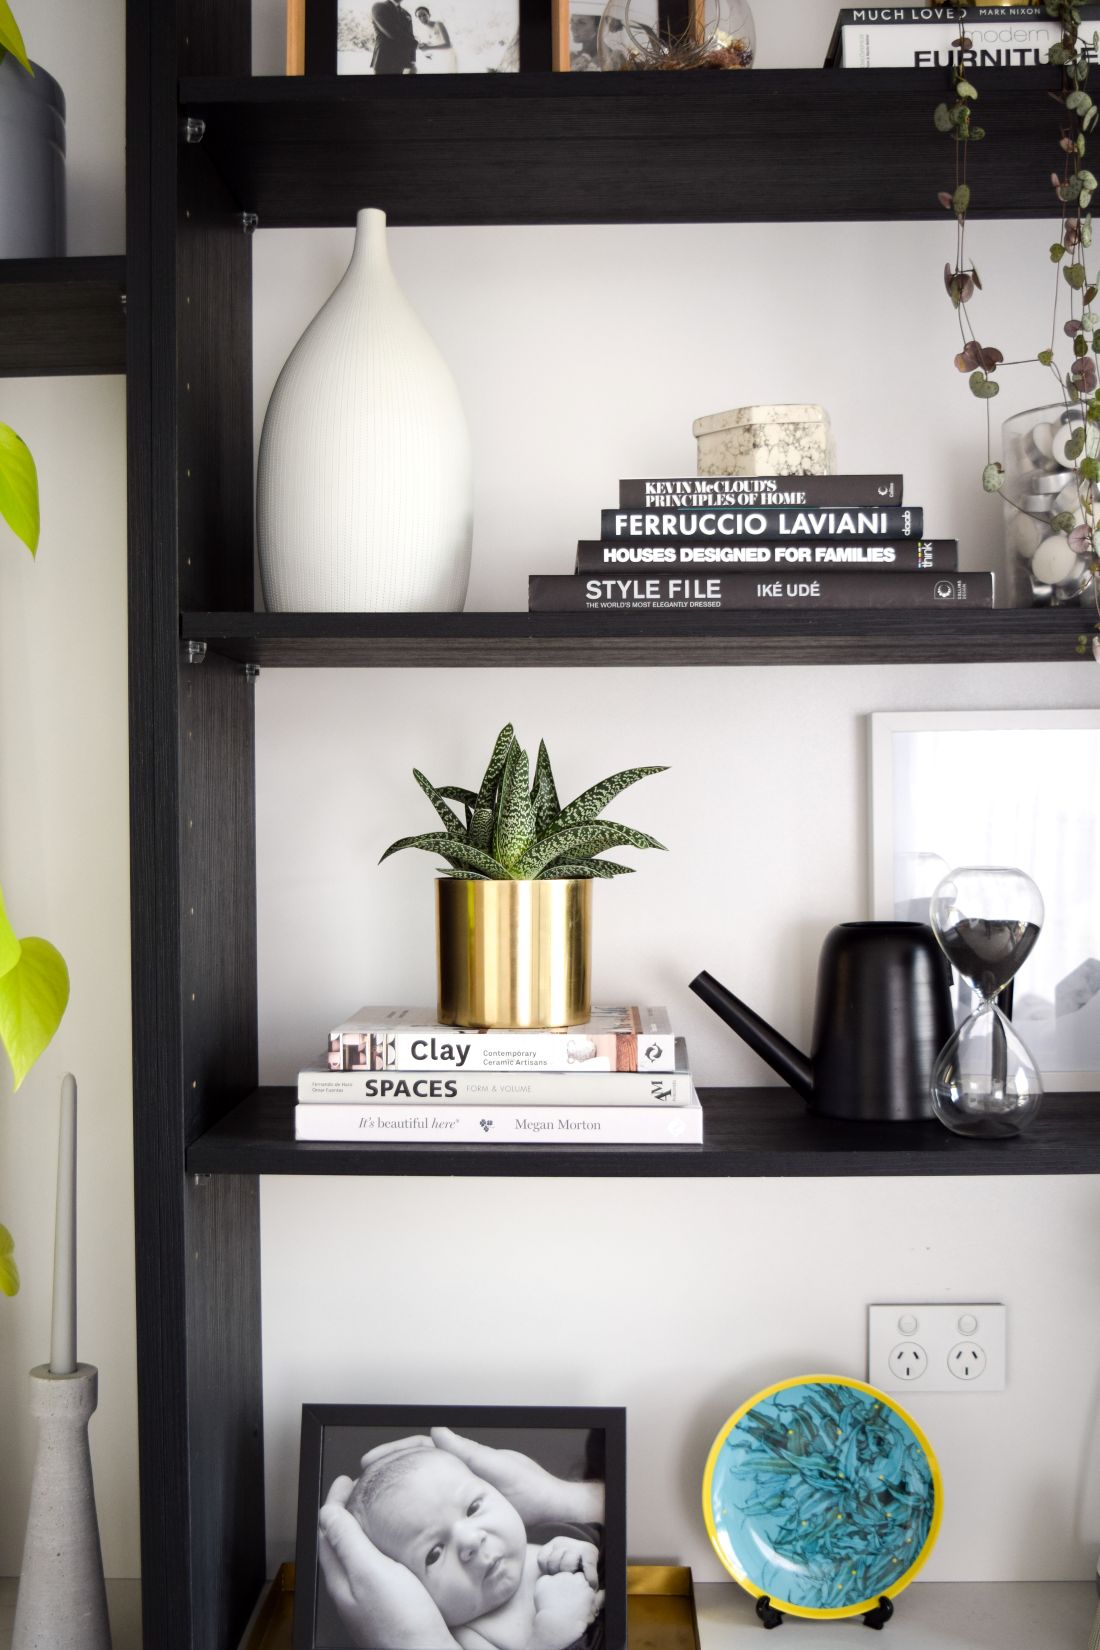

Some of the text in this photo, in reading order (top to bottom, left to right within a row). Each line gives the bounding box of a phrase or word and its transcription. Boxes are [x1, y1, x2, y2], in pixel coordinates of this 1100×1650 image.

[853, 10, 904, 21] MUCH
[979, 8, 1006, 16] MARK
[963, 25, 1050, 43] modern
[914, 48, 1099, 67] FURNITUE
[645, 480, 777, 494] KEVIN McCLOUD'S
[645, 492, 806, 508] PRINCIPLES OF HOME
[614, 512, 888, 536] FERRUCCIO LAVIANI
[603, 547, 897, 563] HOUSES DESIGNED FOR FAMILIES
[922, 542, 933, 568] think
[586, 579, 722, 600] STYLE FILE
[757, 580, 821, 597] IKÉ UDÉ
[411, 1038, 471, 1067] Clay
[483, 1050, 537, 1059] Contemporary
[483, 1058, 548, 1066] Ceramic Artisans
[365, 1079, 458, 1098] SPACES
[467, 1085, 532, 1093] FORM & VOLUME
[358, 1117, 375, 1129] It's
[377, 1117, 429, 1129] beautiful
[514, 1118, 601, 1132] Megan Morton
